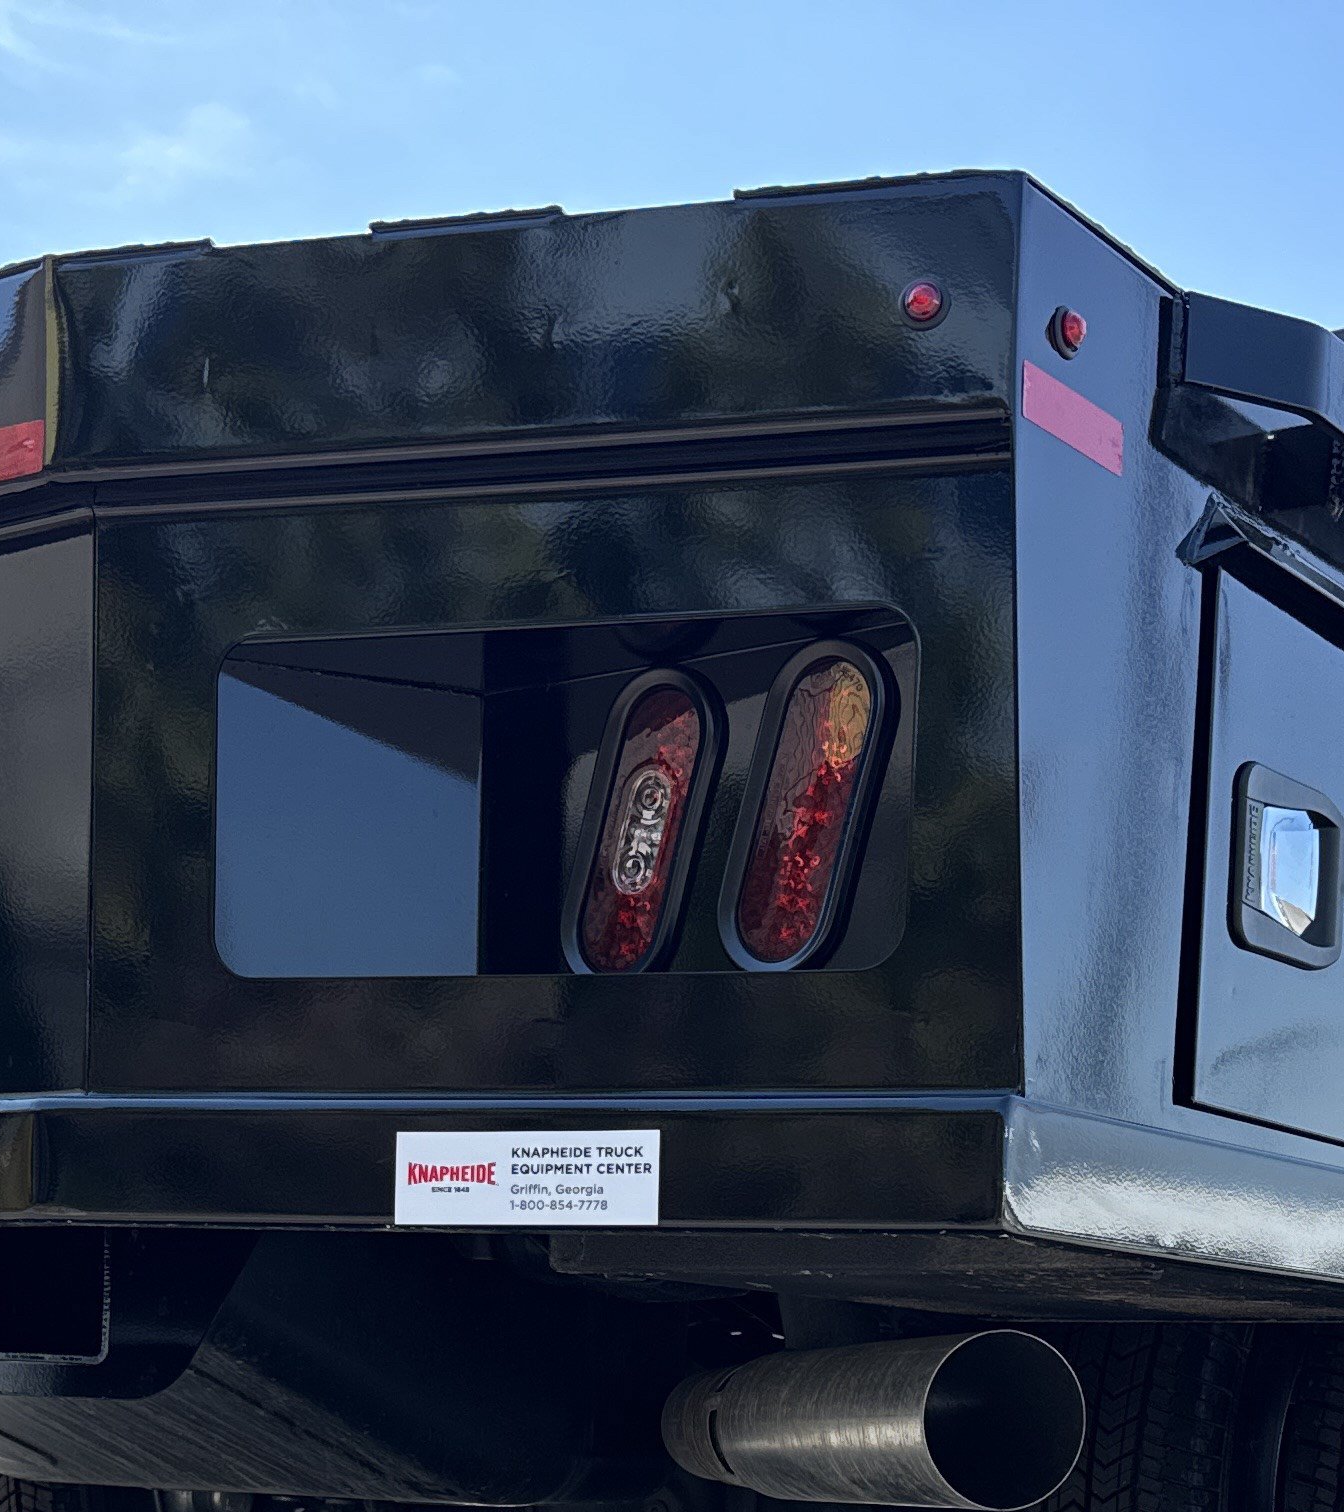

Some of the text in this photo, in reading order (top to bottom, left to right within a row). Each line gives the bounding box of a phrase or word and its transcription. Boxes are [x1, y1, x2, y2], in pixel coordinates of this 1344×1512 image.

[511, 1146, 644, 1158] KNAPHEIDE TRUCK
[407, 1161, 496, 1185] KNAPHEIDE
[511, 1163, 652, 1175] EQUIPMENT CENTER
[510, 1183, 604, 1196] Griffin, Georgia
[510, 1199, 608, 1211] 1-800-854-7778
